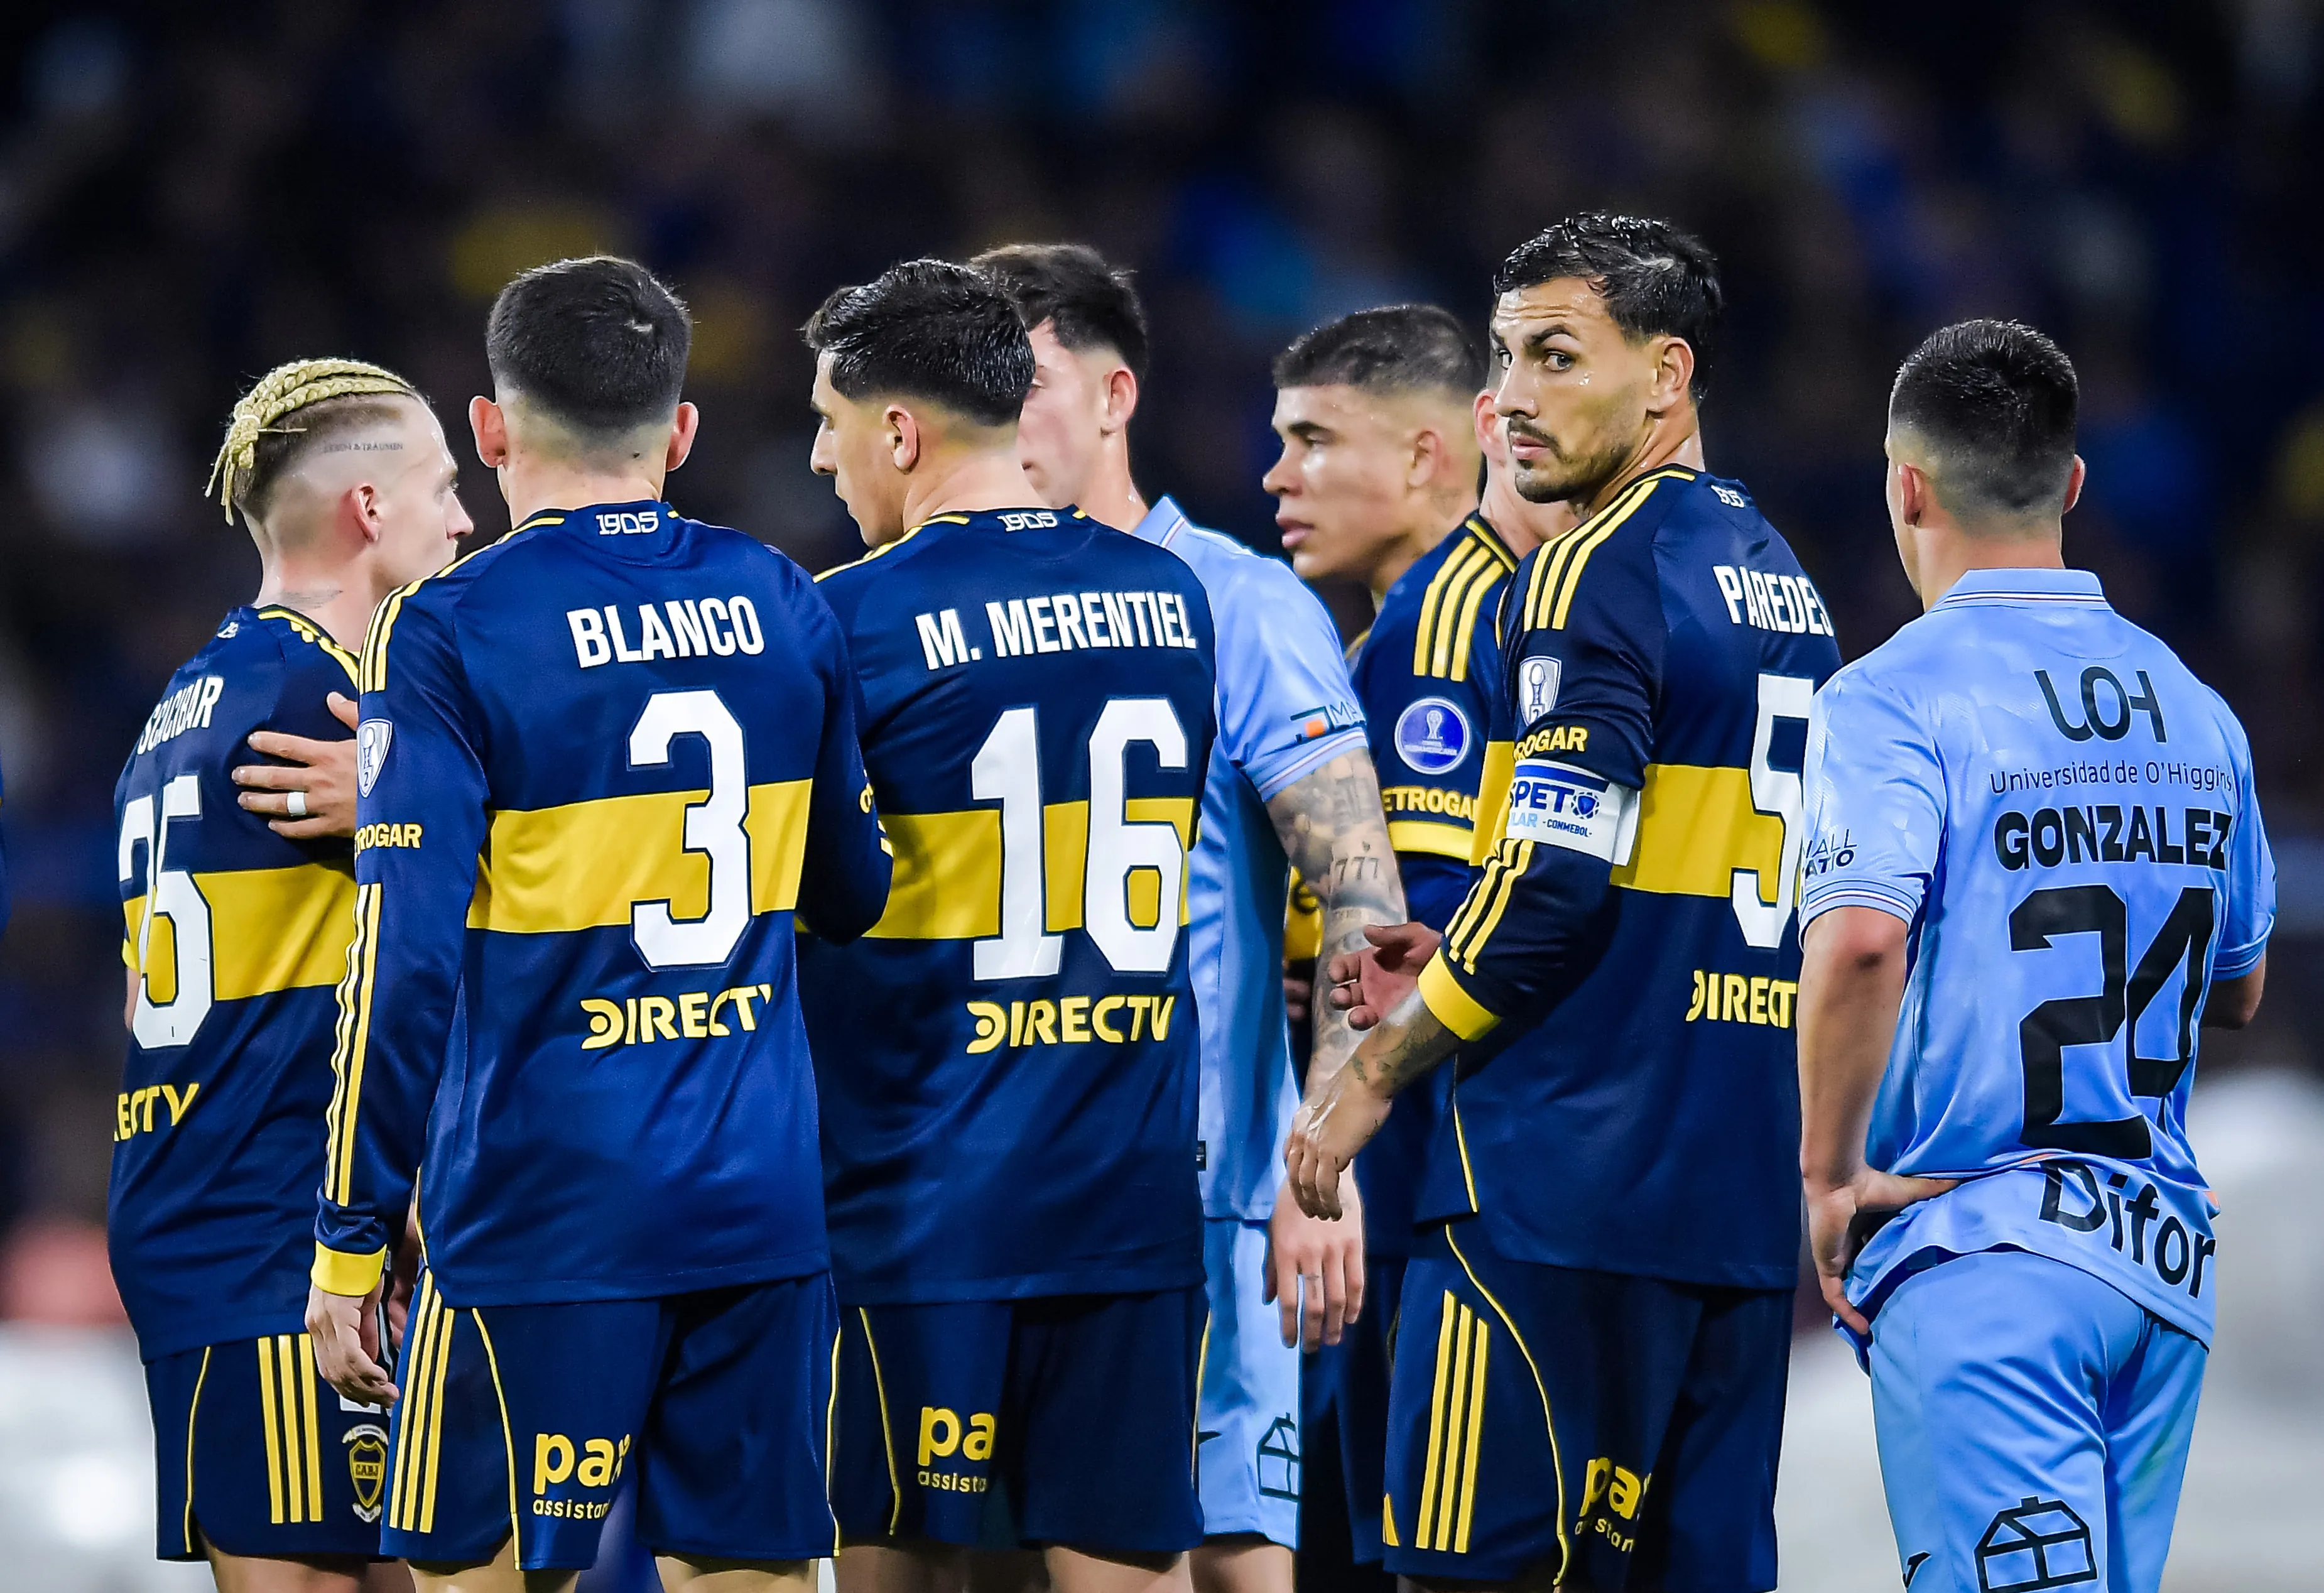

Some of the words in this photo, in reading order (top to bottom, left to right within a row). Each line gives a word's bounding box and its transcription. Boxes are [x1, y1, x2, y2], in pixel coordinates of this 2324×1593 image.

[595, 511, 660, 536] 1905
[999, 509, 1058, 532] 1905
[567, 595, 765, 669] BLANCO
[915, 608, 982, 670] M.
[985, 592, 1197, 658] MERENTIEL
[1382, 786, 1480, 822] ETROGA
[1990, 760, 2110, 794] Universidad
[2114, 759, 2138, 784] de
[2145, 761, 2232, 792] O'Higgins
[629, 690, 754, 967] 3
[971, 699, 1186, 981] 16
[1730, 673, 1814, 949] 5
[1994, 805, 2233, 871] GONZALEZ
[1805, 849, 1855, 879] ATIO
[966, 996, 1175, 1053] DIRECTV
[1686, 970, 1797, 1028] DIRECT
[2009, 884, 2214, 1161] 24
[114, 1083, 200, 1142] ECTV
[2039, 1160, 2216, 1299] Difor
